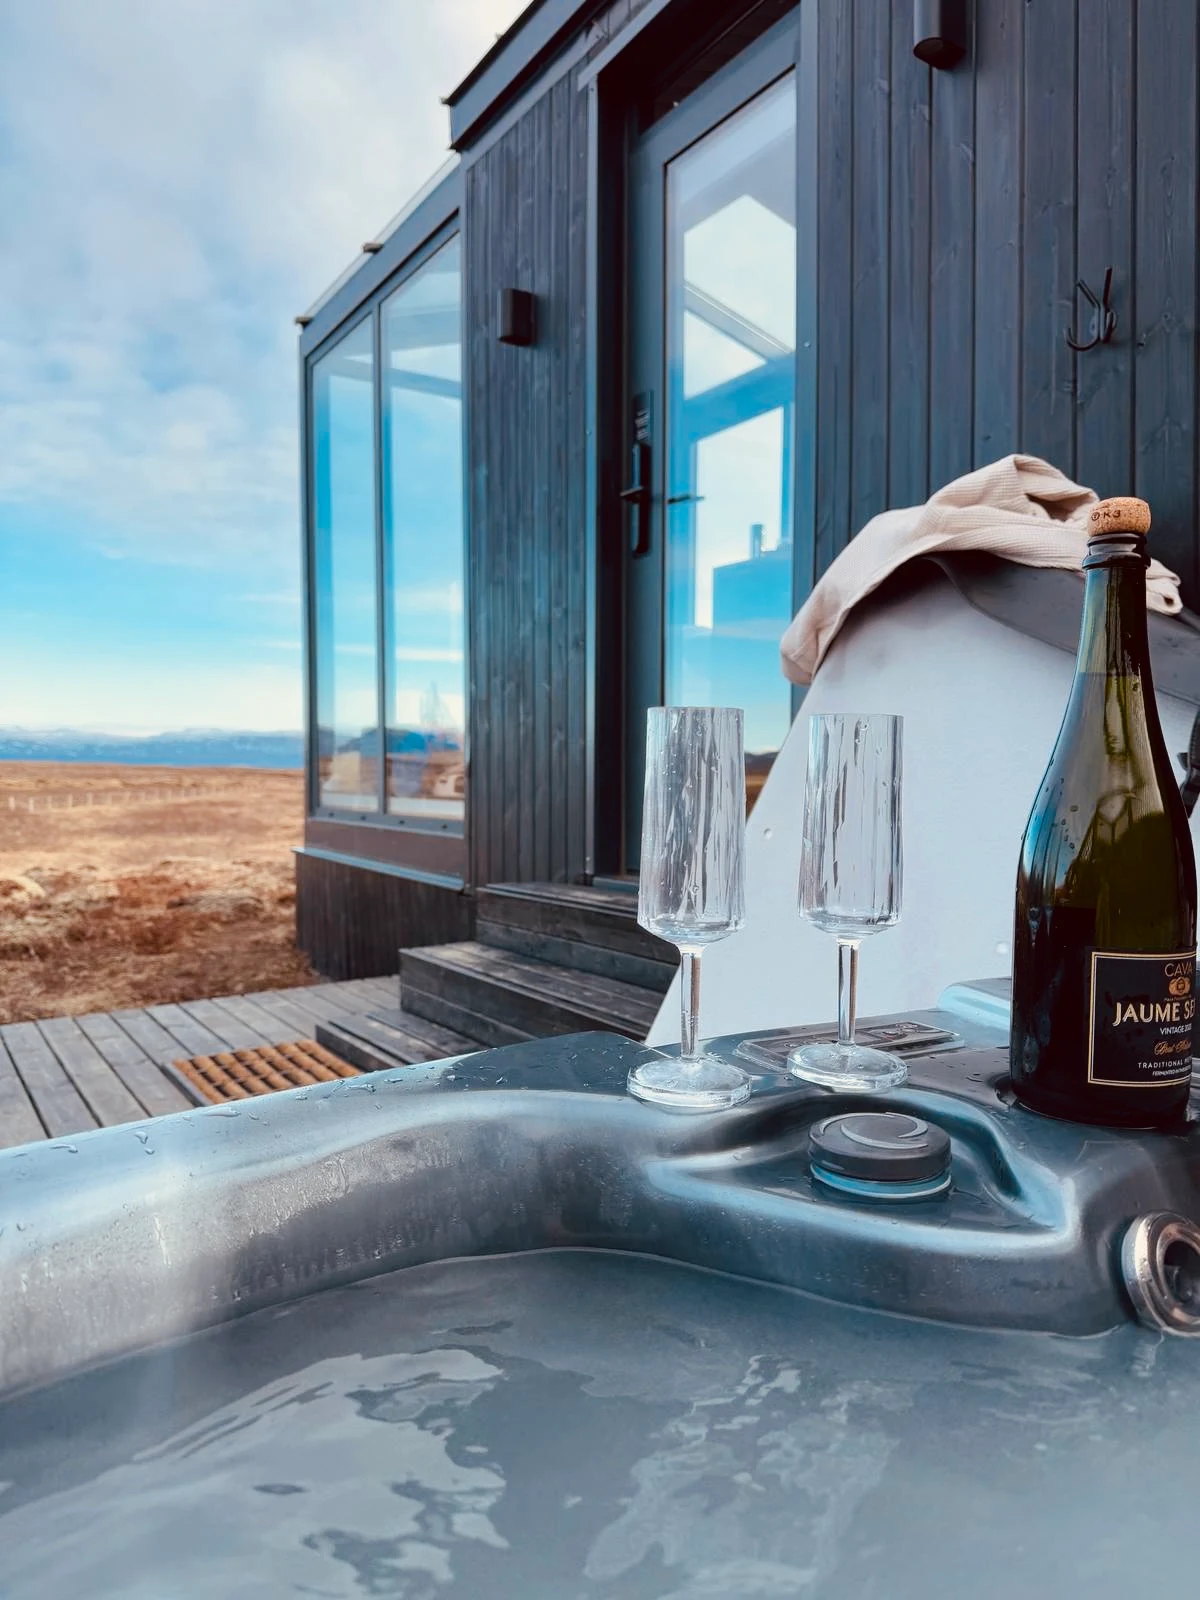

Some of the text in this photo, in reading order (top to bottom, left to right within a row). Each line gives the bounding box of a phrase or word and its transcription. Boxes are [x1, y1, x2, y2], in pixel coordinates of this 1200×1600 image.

[1164, 961, 1193, 977] CAVA
[1112, 1002, 1181, 1027] JAUME
[1160, 1025, 1184, 1035] VINTAGE
[1137, 1059, 1183, 1069] TRADITIONAL
